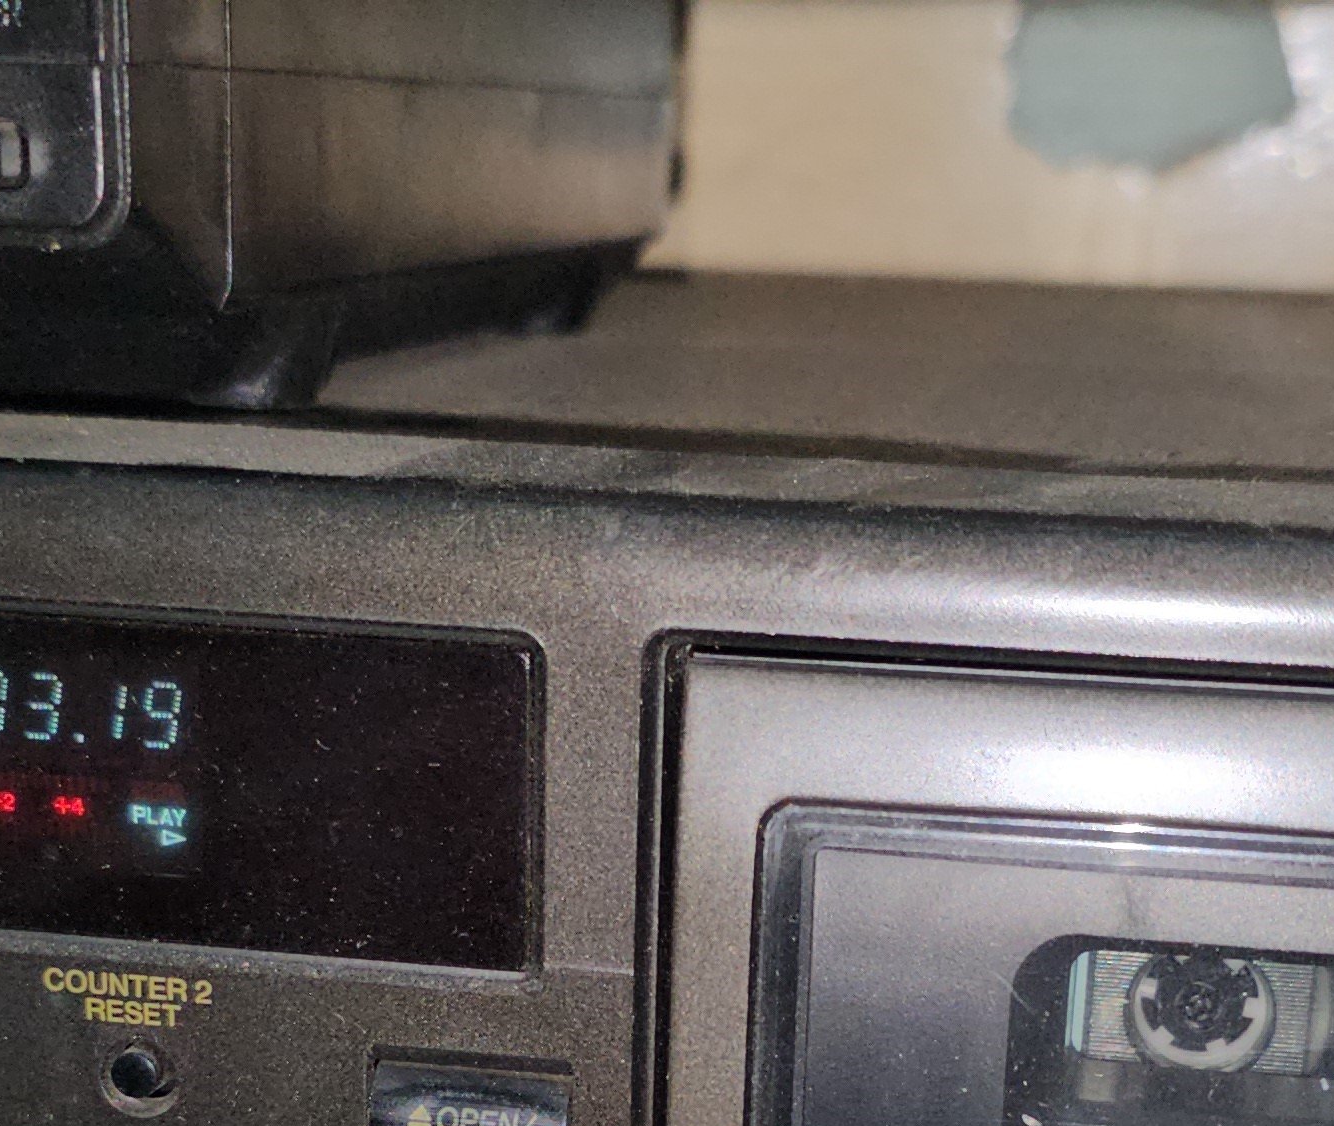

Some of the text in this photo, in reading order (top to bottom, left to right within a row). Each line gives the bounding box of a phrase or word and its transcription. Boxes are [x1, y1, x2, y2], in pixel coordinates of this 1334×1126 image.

[128, 803, 187, 828] PLAY
[43, 967, 212, 1005] COUNTER 2
[84, 997, 181, 1027] RESET
